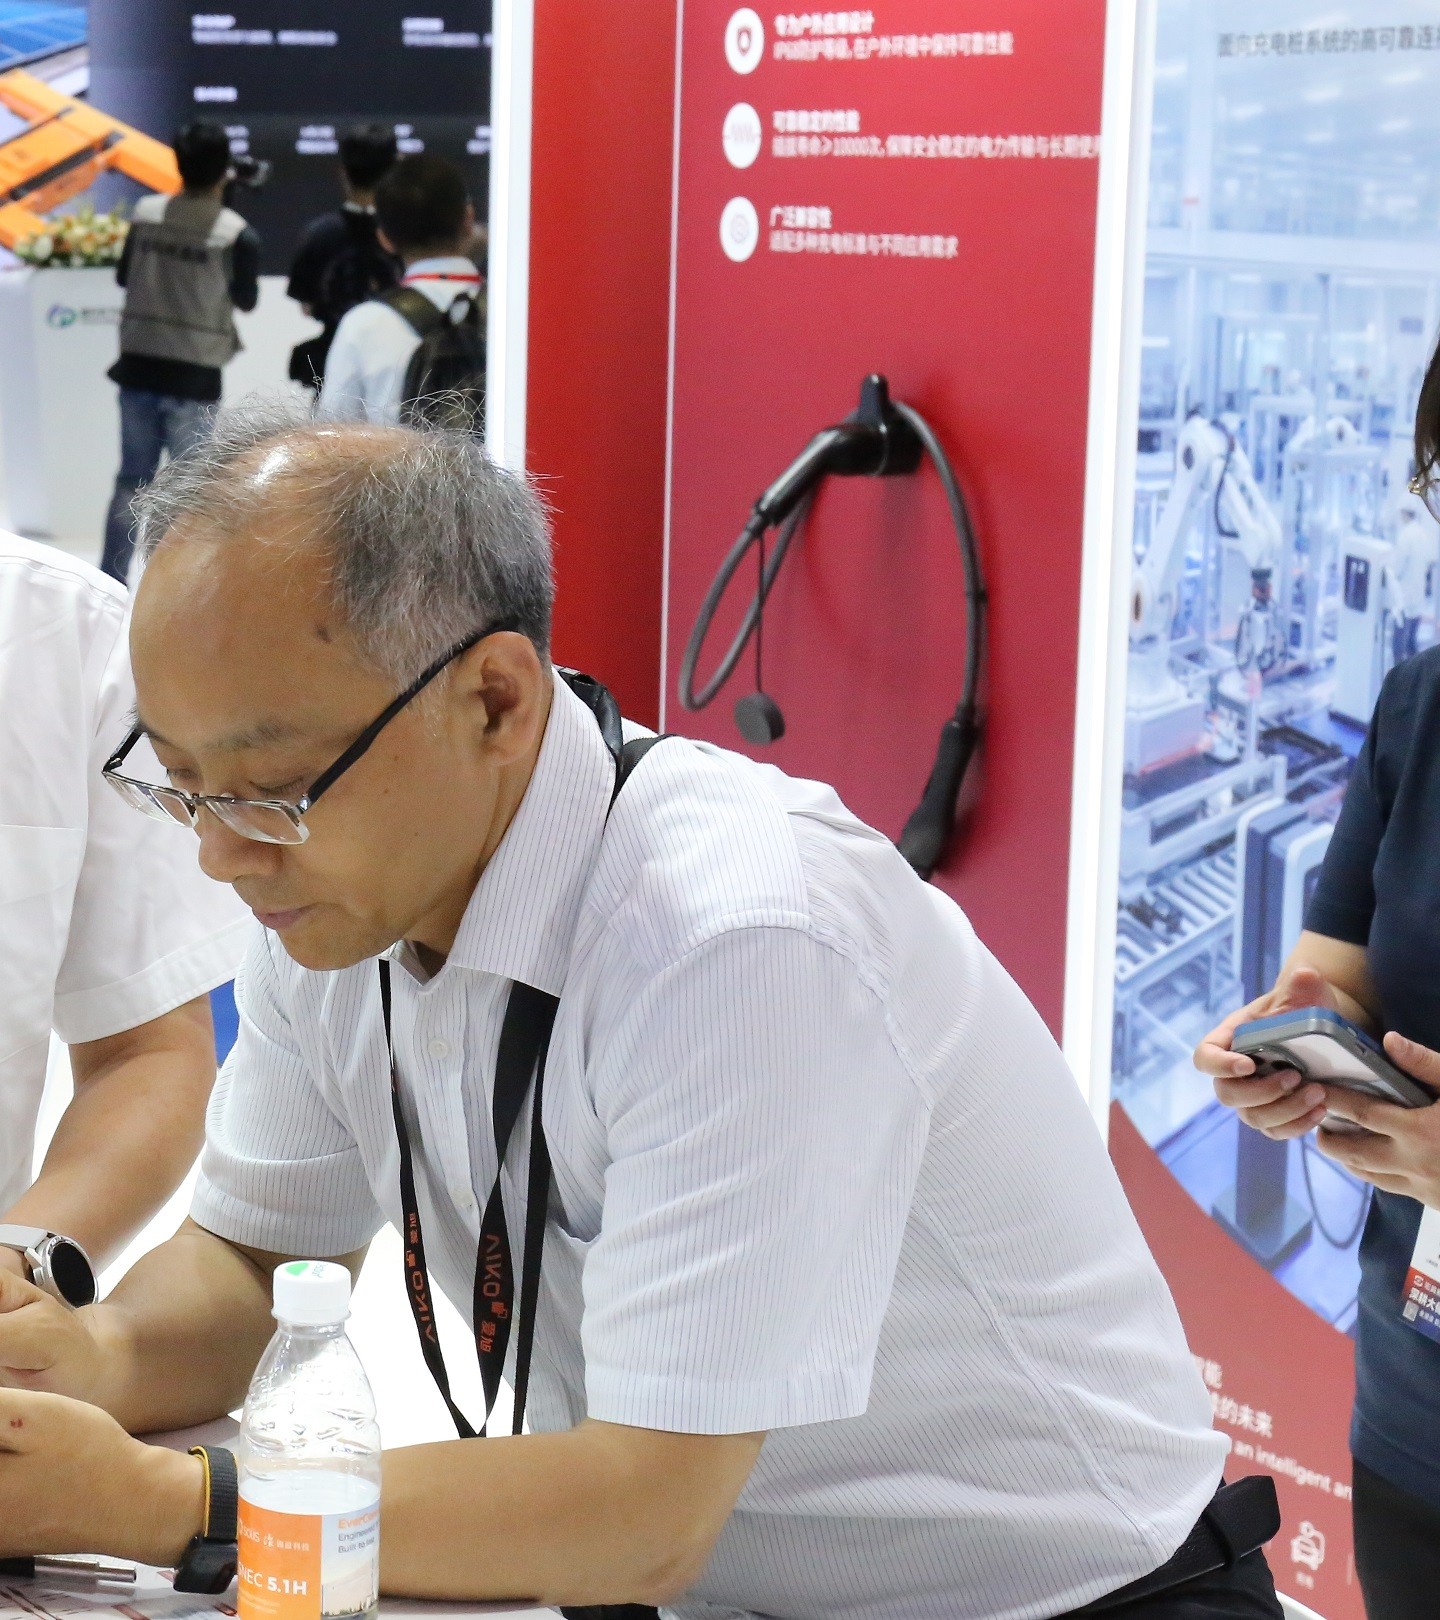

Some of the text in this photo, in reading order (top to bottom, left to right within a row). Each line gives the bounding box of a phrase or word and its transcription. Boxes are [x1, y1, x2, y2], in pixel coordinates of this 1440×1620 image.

[1217, 24, 1440, 57] 面向充电桩系统的高可靠连
[1255, 1446, 1331, 1492] intelligent
[267, 1576, 307, 1596] 5.1H
